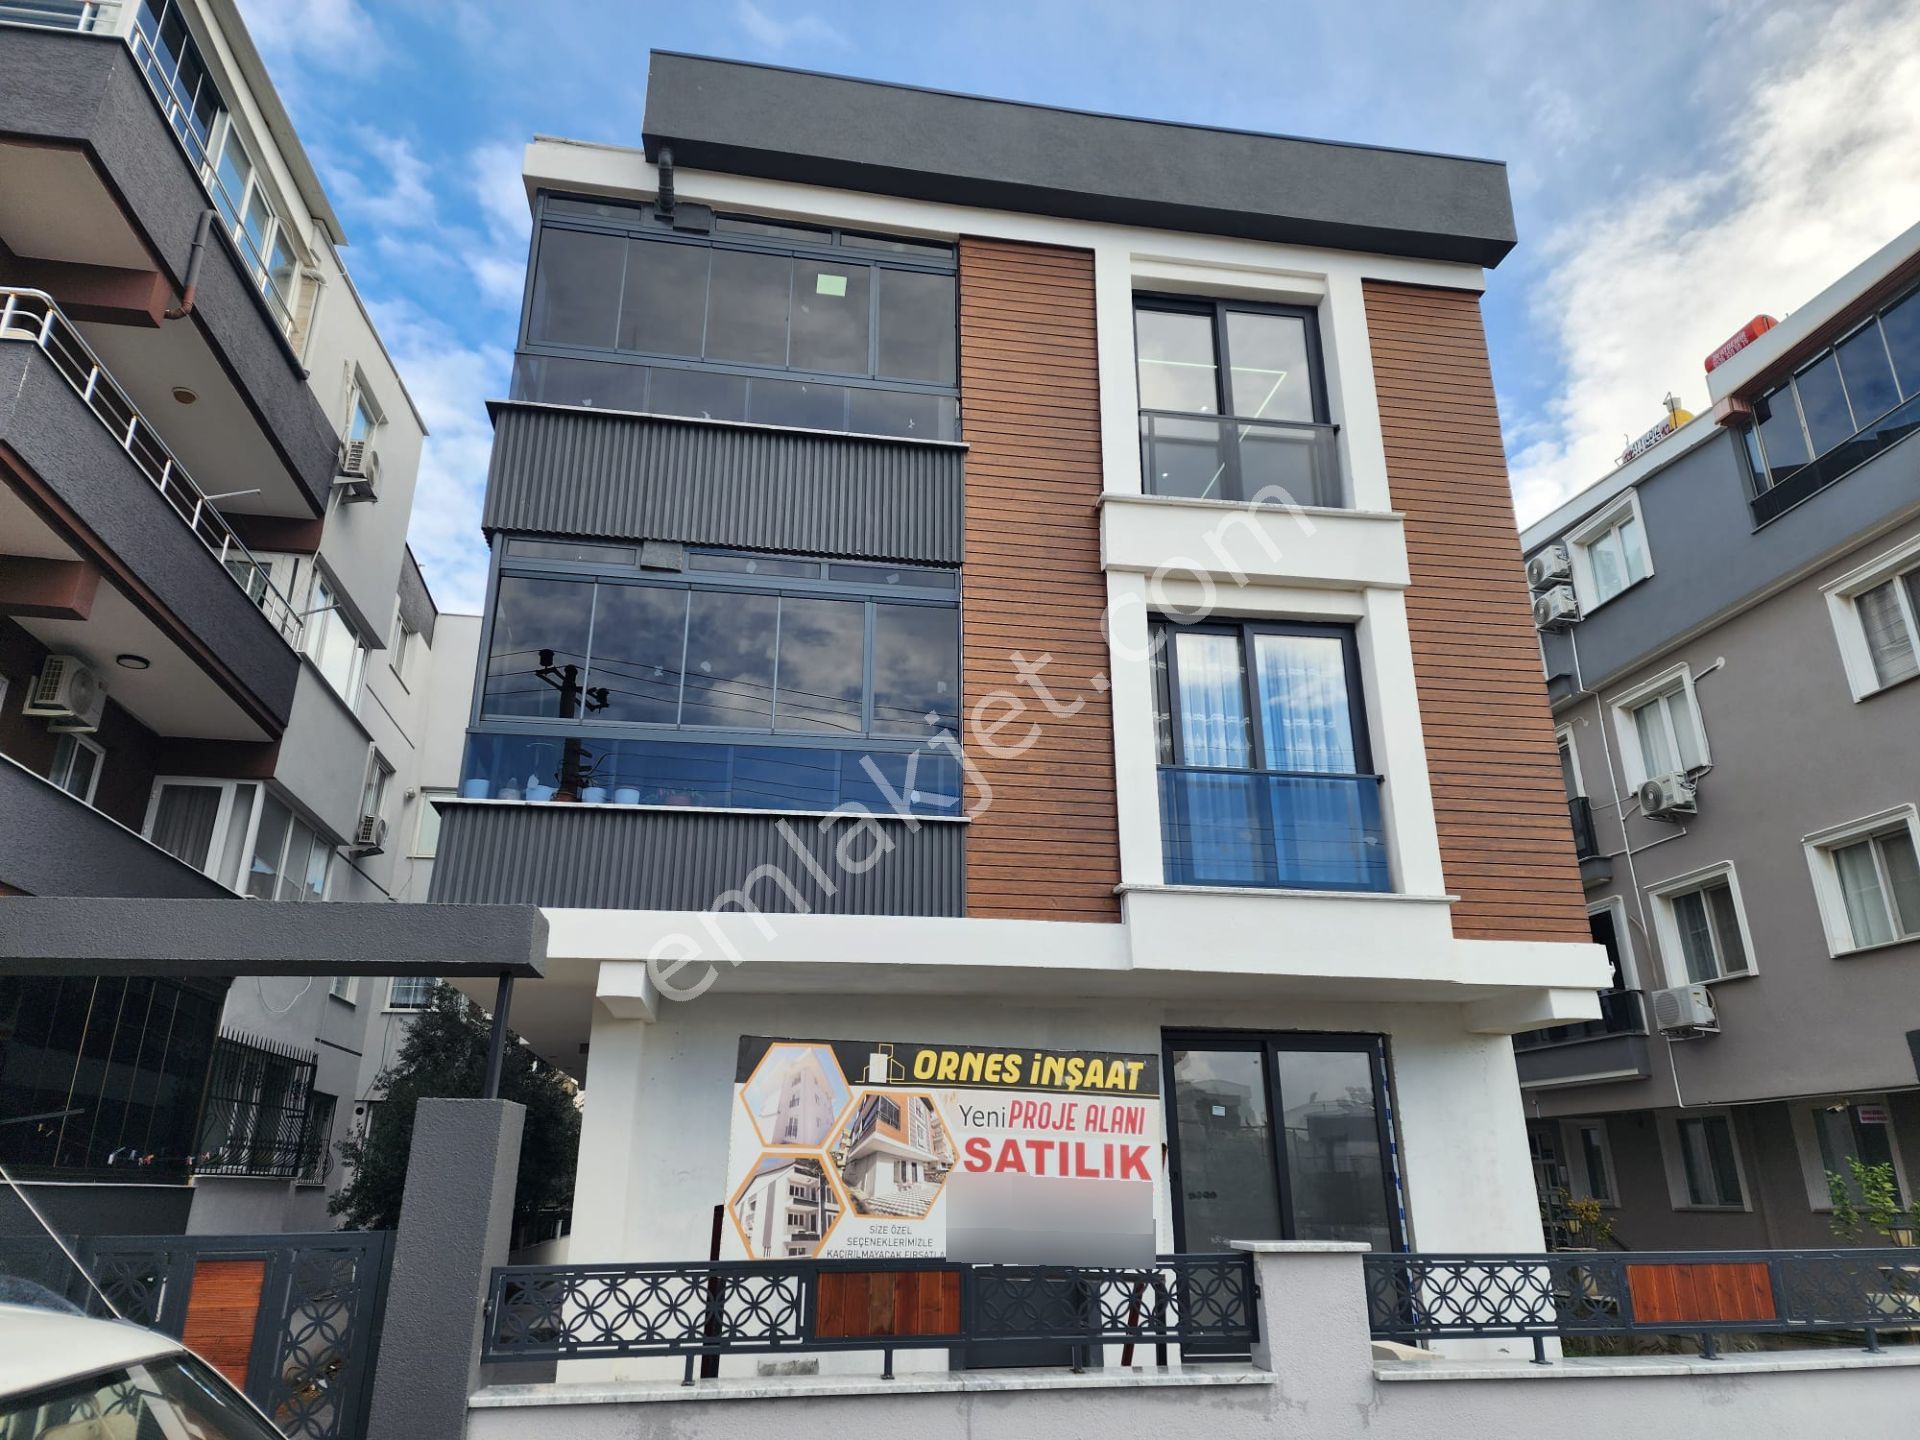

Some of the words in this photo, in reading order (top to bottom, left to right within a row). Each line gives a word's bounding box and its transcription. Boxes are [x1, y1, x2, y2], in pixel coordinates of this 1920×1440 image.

[913, 1049, 1022, 1084] ORNES
[959, 1104, 1006, 1128] Yeni
[1008, 1100, 1078, 1131] PROJE
[1085, 1104, 1145, 1135] ALANI
[963, 1136, 1152, 1181] SATILIK
[847, 1237, 933, 1248] SEÇENEKLERİMİZLE
[869, 1224, 888, 1235] SİZE
[891, 1224, 912, 1235] ÖZEL
